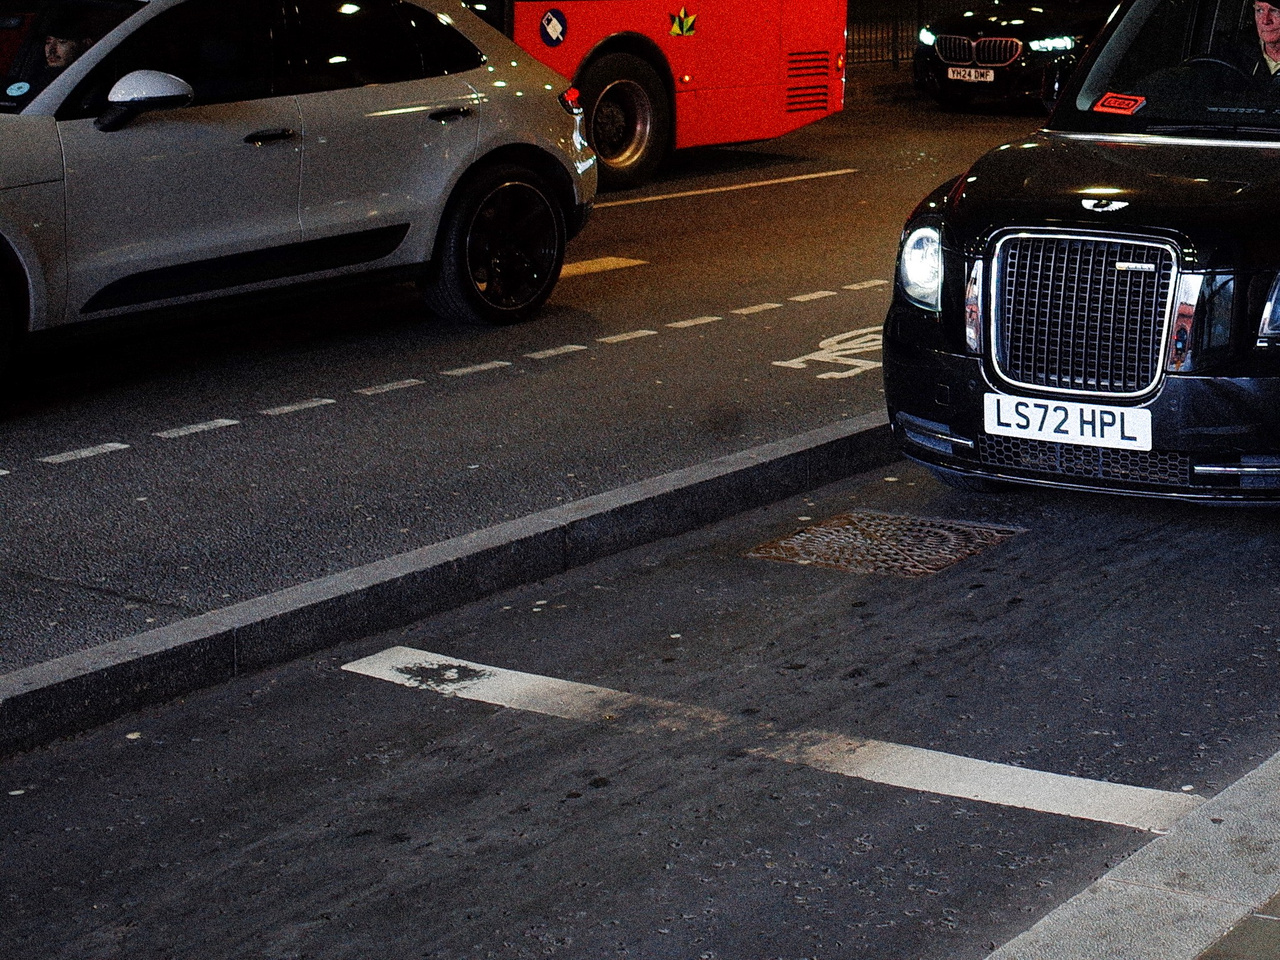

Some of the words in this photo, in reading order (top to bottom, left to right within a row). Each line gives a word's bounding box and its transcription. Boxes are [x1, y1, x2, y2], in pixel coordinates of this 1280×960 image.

[950, 68, 972, 80] YH24
[974, 69, 991, 81] DMF
[996, 398, 1070, 435] LS72
[1078, 407, 1138, 442] HPL
